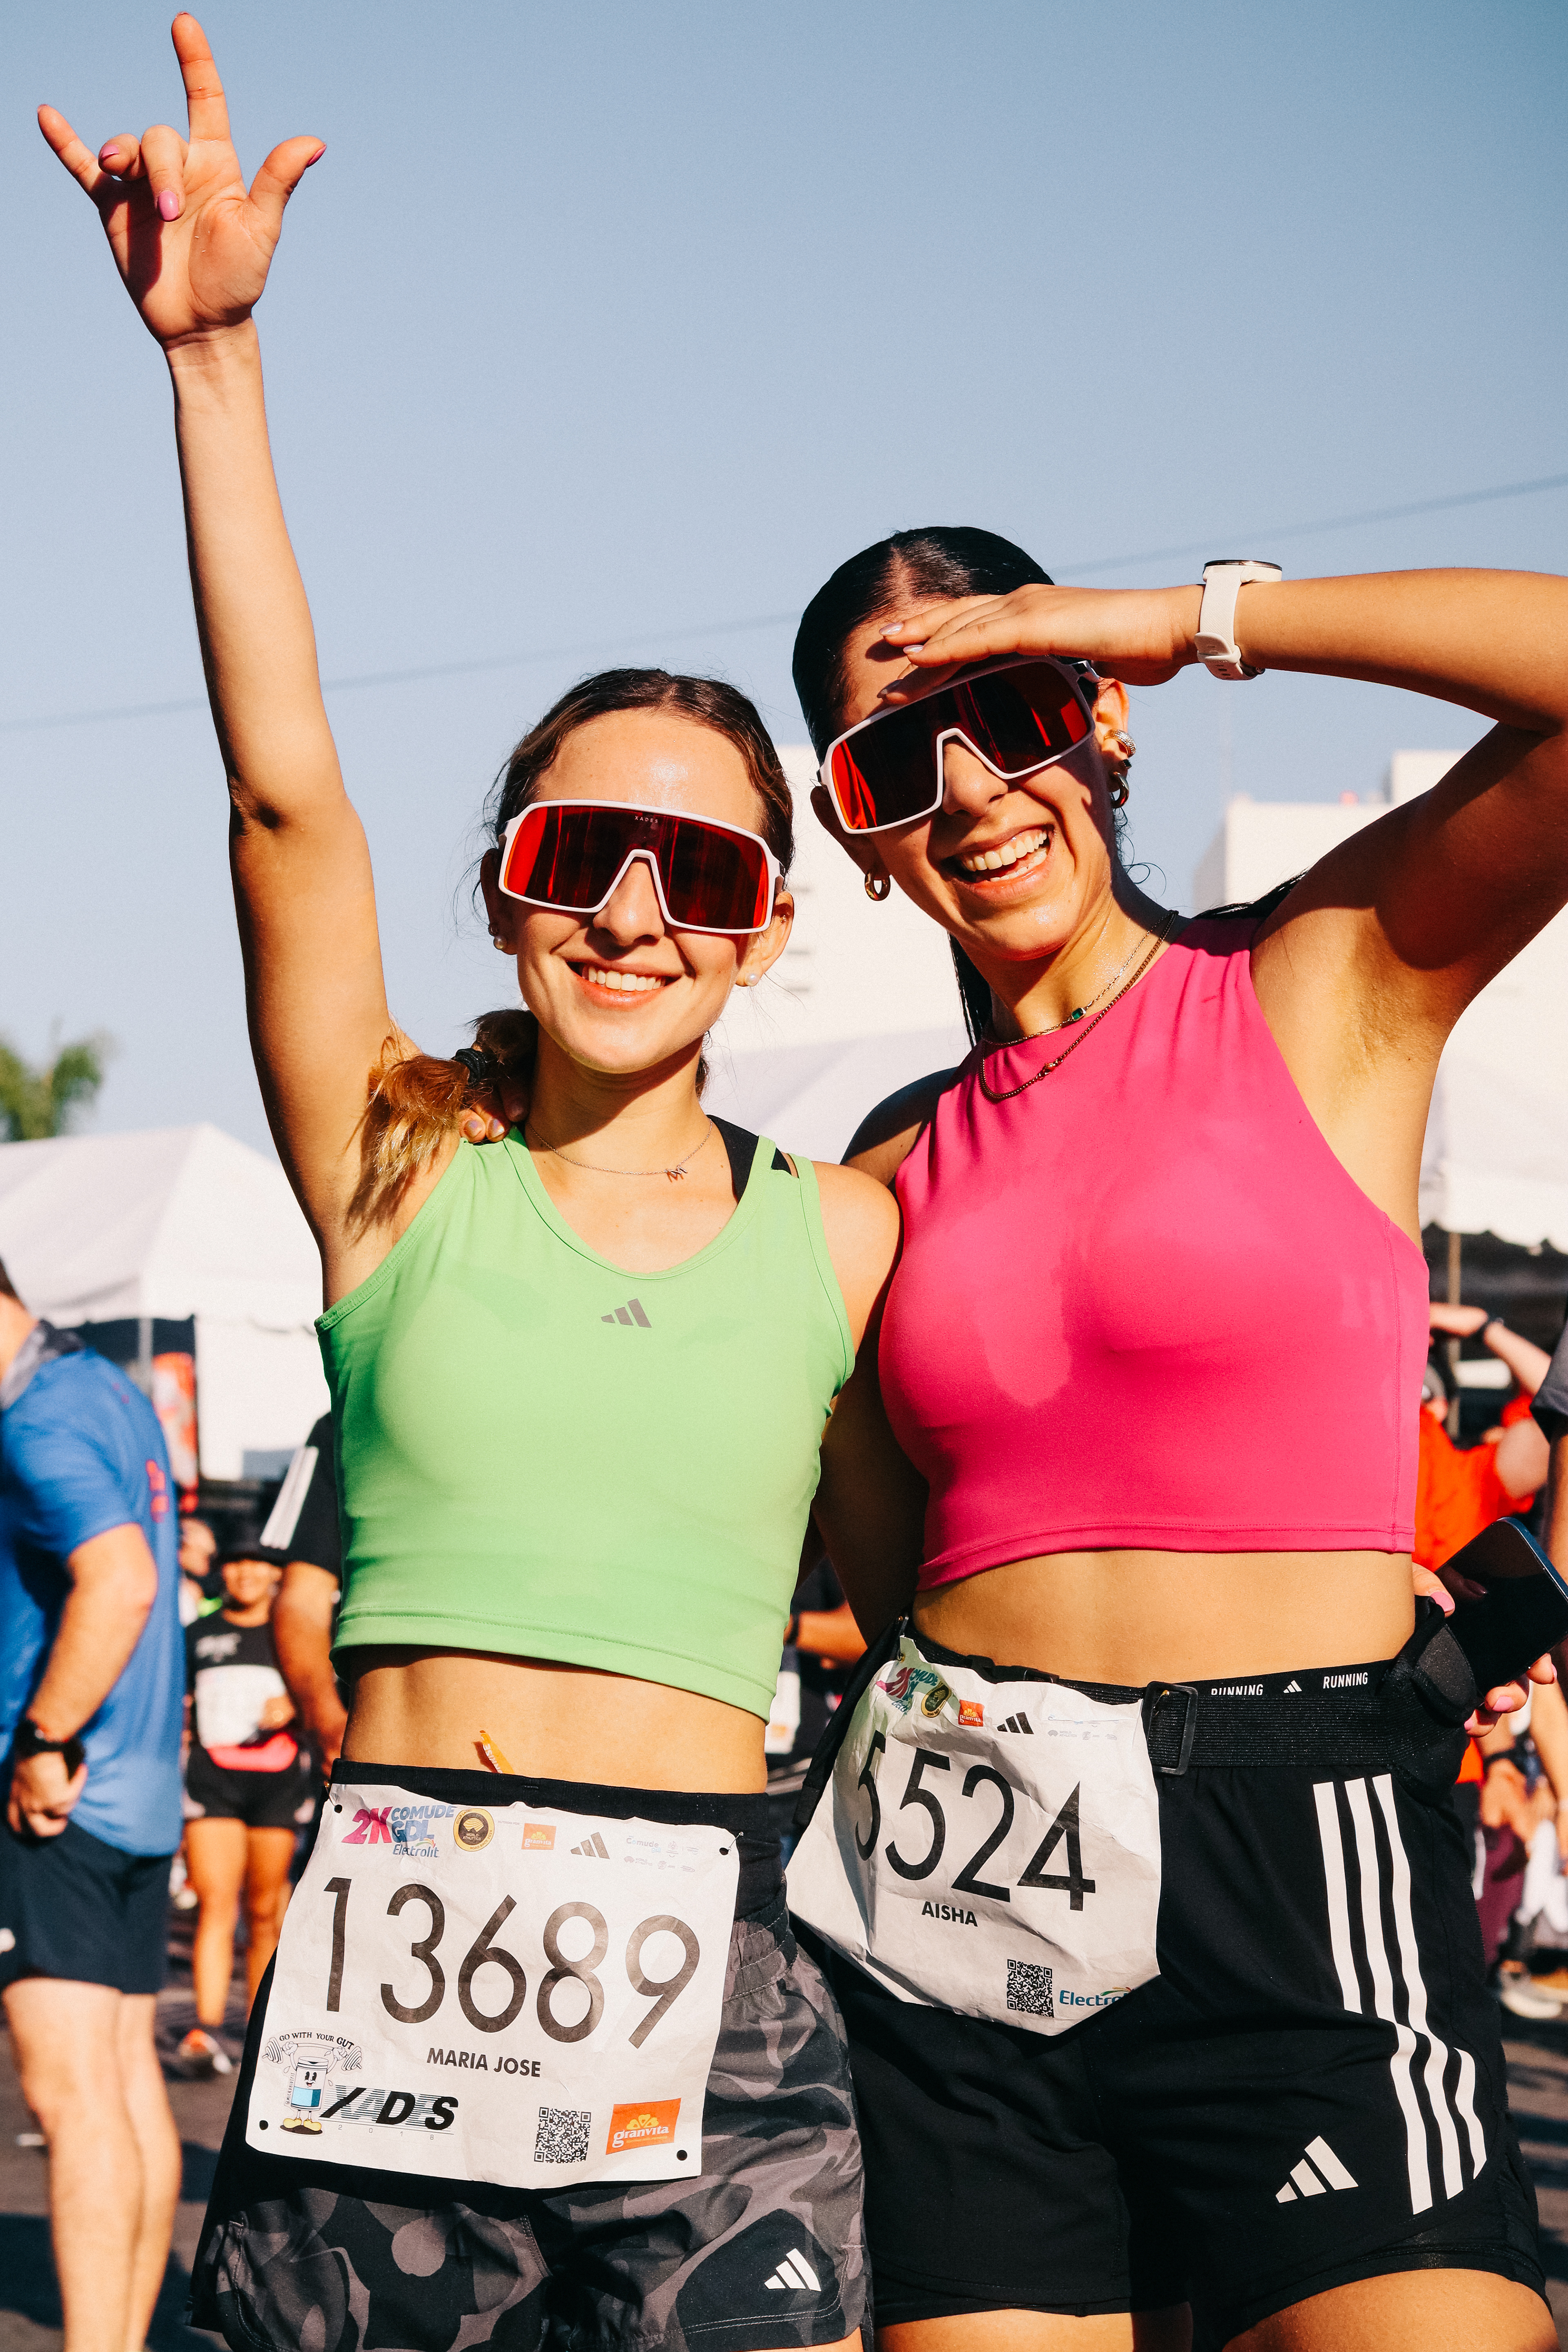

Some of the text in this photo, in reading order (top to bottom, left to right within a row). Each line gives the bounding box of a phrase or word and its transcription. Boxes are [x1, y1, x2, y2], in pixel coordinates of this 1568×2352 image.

[635, 815, 658, 824] XADES
[1323, 1672, 1368, 1689] RUNNING
[391, 1805, 457, 1820] COMUDE
[855, 1729, 1096, 1911] 5524
[391, 1820, 435, 1843] GDL
[392, 1844, 439, 1858] Electrolit
[524, 1838, 552, 1847] granvita
[921, 1901, 978, 1927] AISHA
[323, 1877, 701, 2049] 13689
[316, 2033, 335, 2042] YOUR
[336, 2037, 355, 2050] GUT
[426, 2047, 541, 2078] MARIA JOSE
[612, 2125, 670, 2148] granvita
